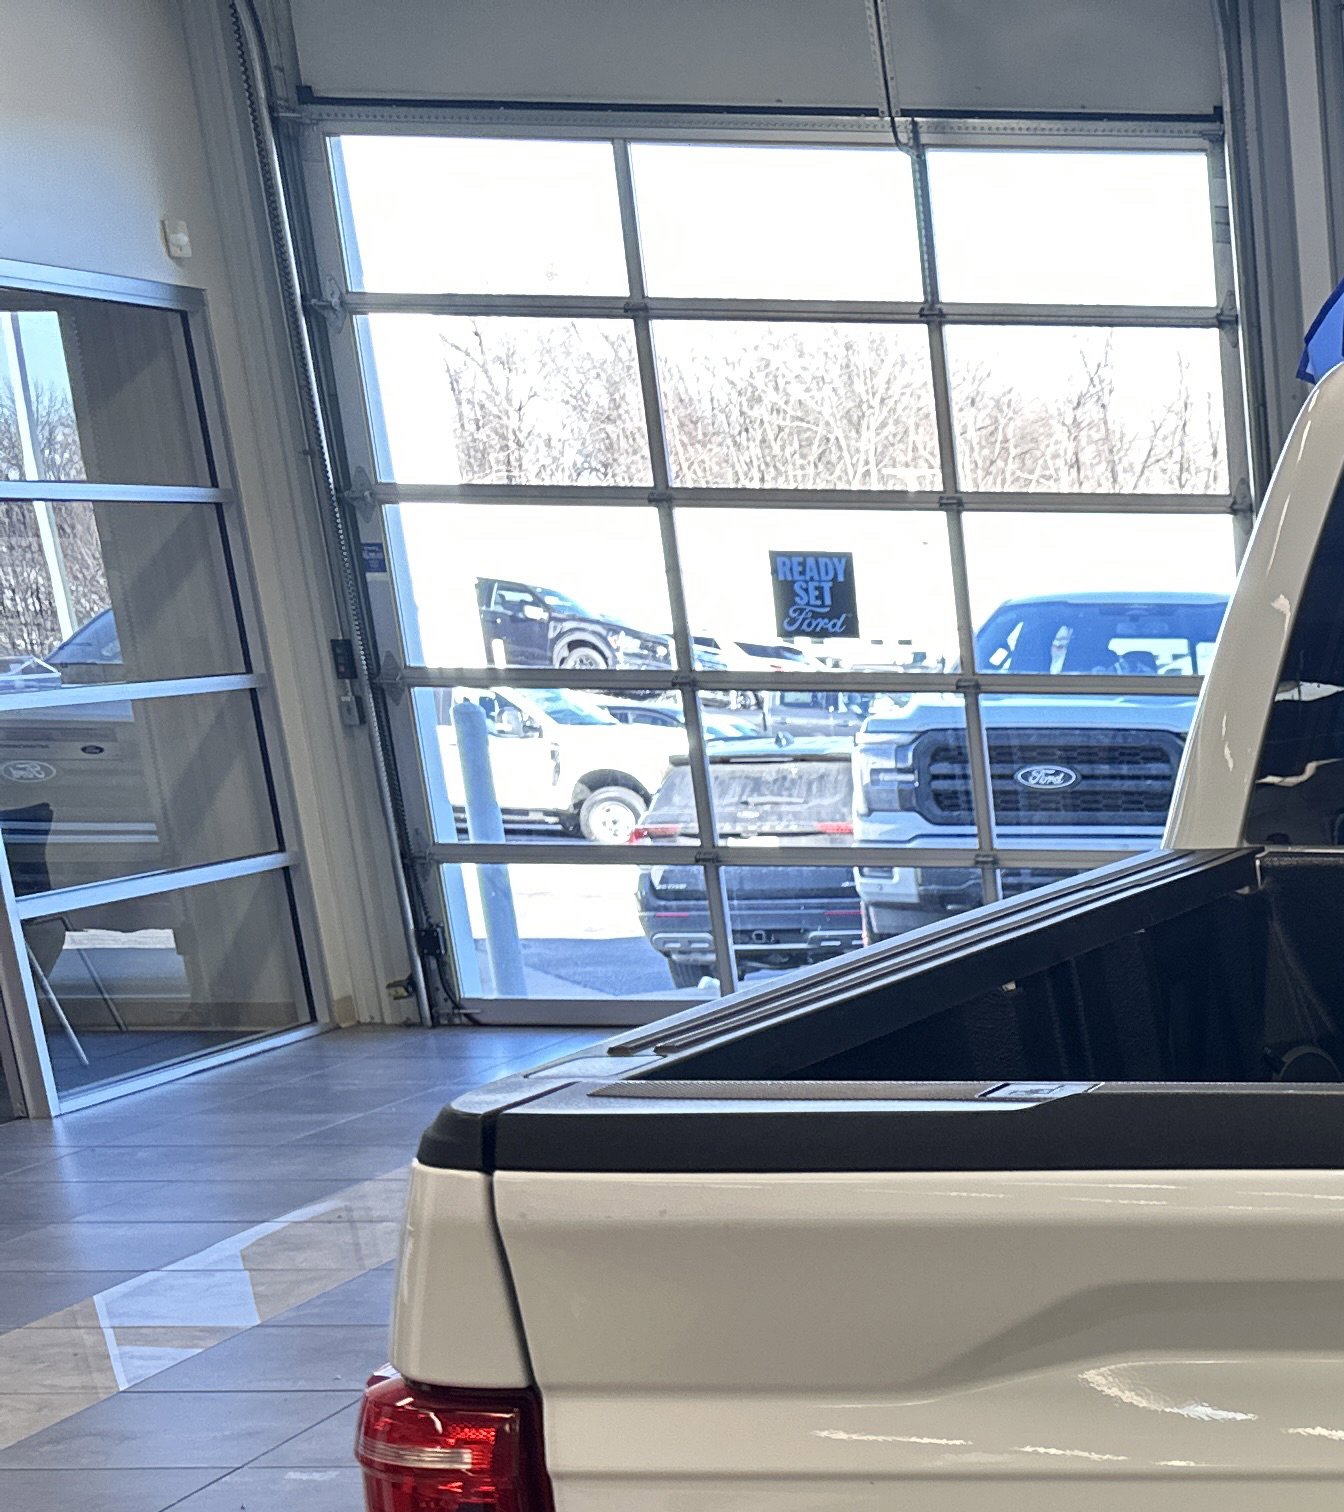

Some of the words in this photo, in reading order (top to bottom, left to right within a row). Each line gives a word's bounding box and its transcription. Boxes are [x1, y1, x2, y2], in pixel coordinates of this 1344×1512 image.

[775, 555, 848, 582] READY
[793, 581, 834, 606] SET
[783, 605, 848, 633] Ford
